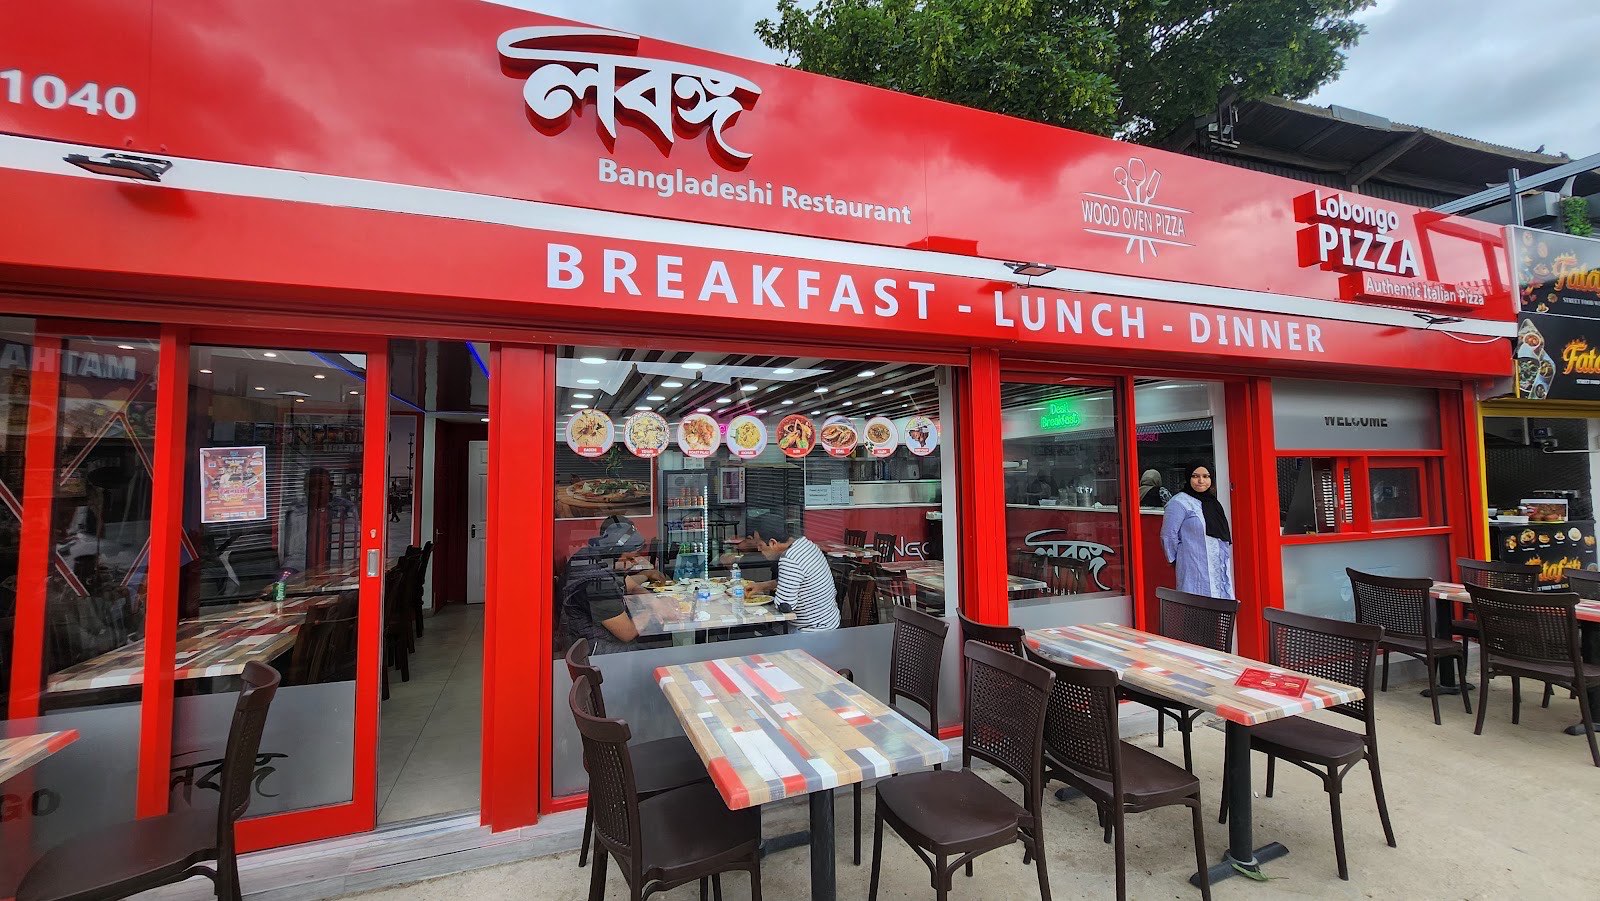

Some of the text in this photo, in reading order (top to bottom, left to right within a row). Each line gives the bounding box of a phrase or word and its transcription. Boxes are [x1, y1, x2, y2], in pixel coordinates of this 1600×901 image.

[1, 68, 137, 121] 1040
[497, 26, 762, 160] লবঙ্গ
[598, 158, 911, 225] Bangladeshi Restaurant
[1315, 189, 1399, 234] Lobongo
[1081, 200, 1187, 238] WOOD OVEN PIZZA
[1318, 223, 1421, 276] PIZZA
[547, 242, 935, 320] BREAKFAST
[994, 290, 1145, 338] LUNCH
[1189, 312, 1325, 353] DINNER
[1366, 277, 1485, 306] Authentic Italian Pizza
[1324, 416, 1388, 428] WELCOME
